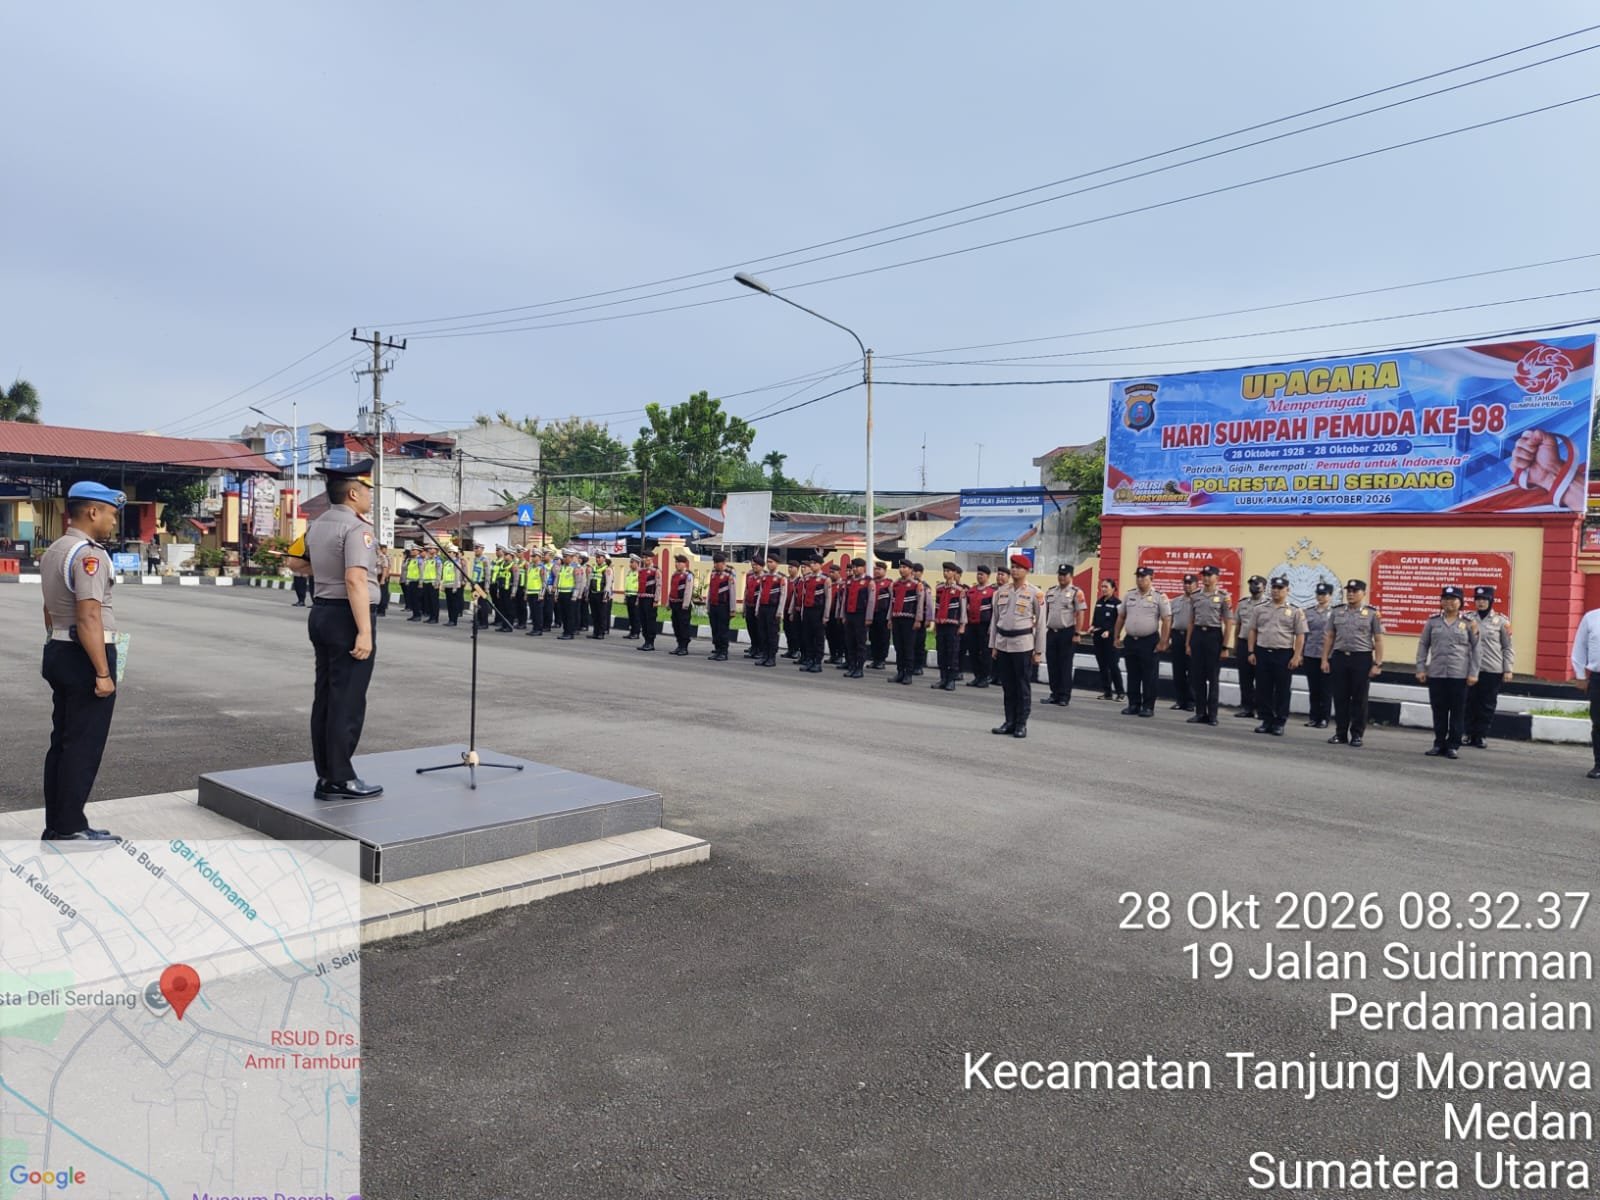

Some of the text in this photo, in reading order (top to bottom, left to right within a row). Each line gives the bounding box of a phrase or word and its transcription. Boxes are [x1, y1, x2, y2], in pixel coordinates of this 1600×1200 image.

[1243, 361, 1400, 399] UPACARA
[1267, 394, 1368, 413] Memperingati
[1162, 405, 1505, 448] HARI SUMPAH PEMUDA KE-98
[1231, 450, 1243, 459] 28
[1244, 448, 1280, 458] Oktober
[1282, 447, 1305, 456] 1928
[1314, 446, 1327, 455] 28
[1329, 443, 1370, 454] Oktober
[1372, 442, 1398, 452] 2026
[1258, 462, 1308, 472] Berempati
[1316, 459, 1361, 469] Pemuda
[1364, 458, 1398, 468] untuk
[1132, 480, 1162, 490] POLISI
[1192, 471, 1455, 493] POLRESTA DELI SERDANG
[1235, 494, 1391, 504] LUBUK PAKAM 28 OKTOBER 2026
[1165, 551, 1181, 559] TRI
[1400, 556, 1478, 565] CATUR PRASETYA
